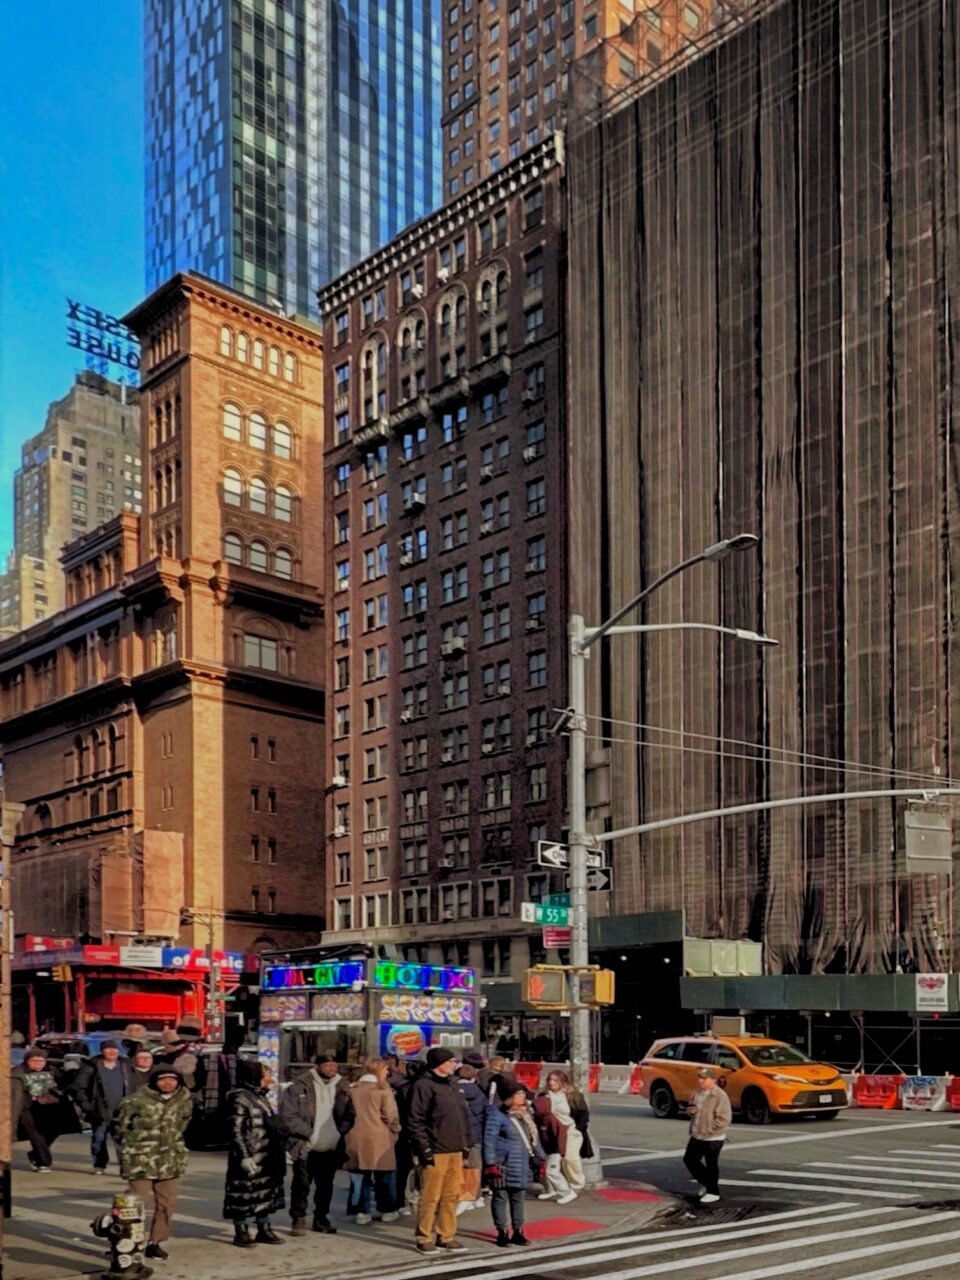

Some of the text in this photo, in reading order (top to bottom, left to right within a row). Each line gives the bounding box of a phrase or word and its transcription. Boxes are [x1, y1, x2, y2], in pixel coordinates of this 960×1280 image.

[546, 908, 559, 922] 55
[172, 953, 190, 966] of
[376, 965, 432, 986] HOT
